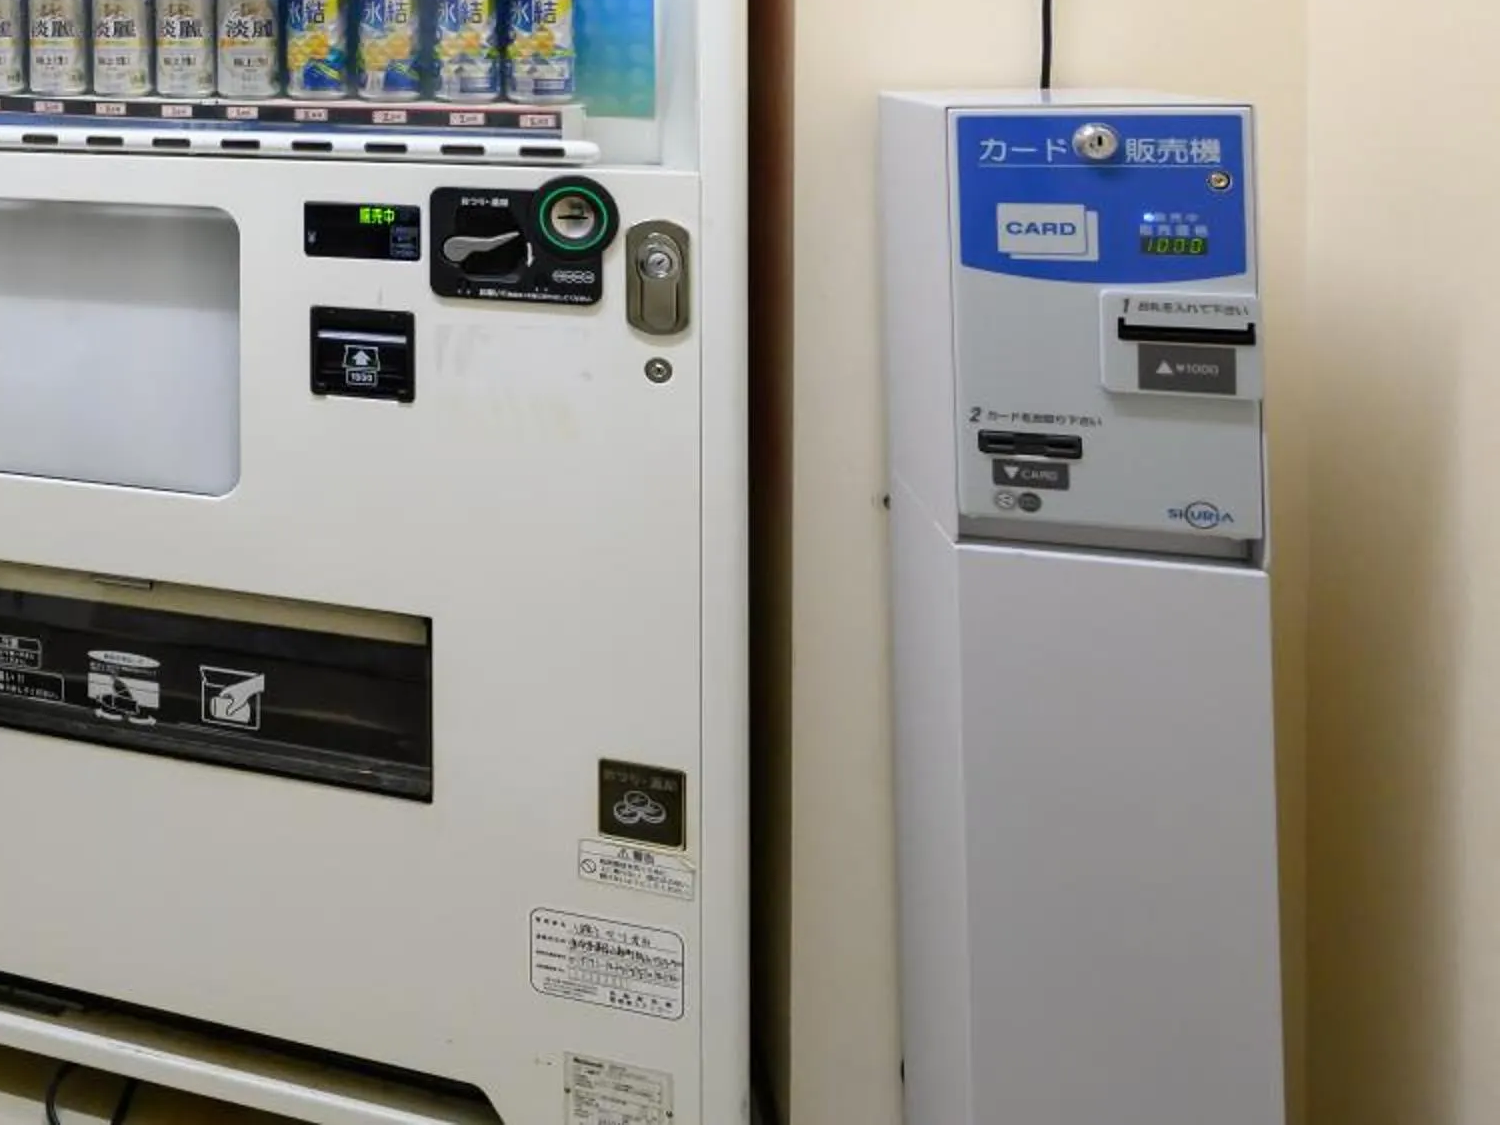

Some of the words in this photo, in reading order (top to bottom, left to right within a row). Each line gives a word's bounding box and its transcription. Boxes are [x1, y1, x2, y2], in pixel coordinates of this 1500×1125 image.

[288, 0, 326, 24] 氷結
[363, 0, 407, 24] 氷結
[437, 0, 483, 24] 氷結
[510, 0, 559, 24] 氷結
[978, 138, 1067, 163] カード
[1124, 138, 1222, 164] 販売機
[358, 207, 396, 225] 販売中
[1006, 221, 1077, 236] CARD
[969, 406, 982, 423] 2
